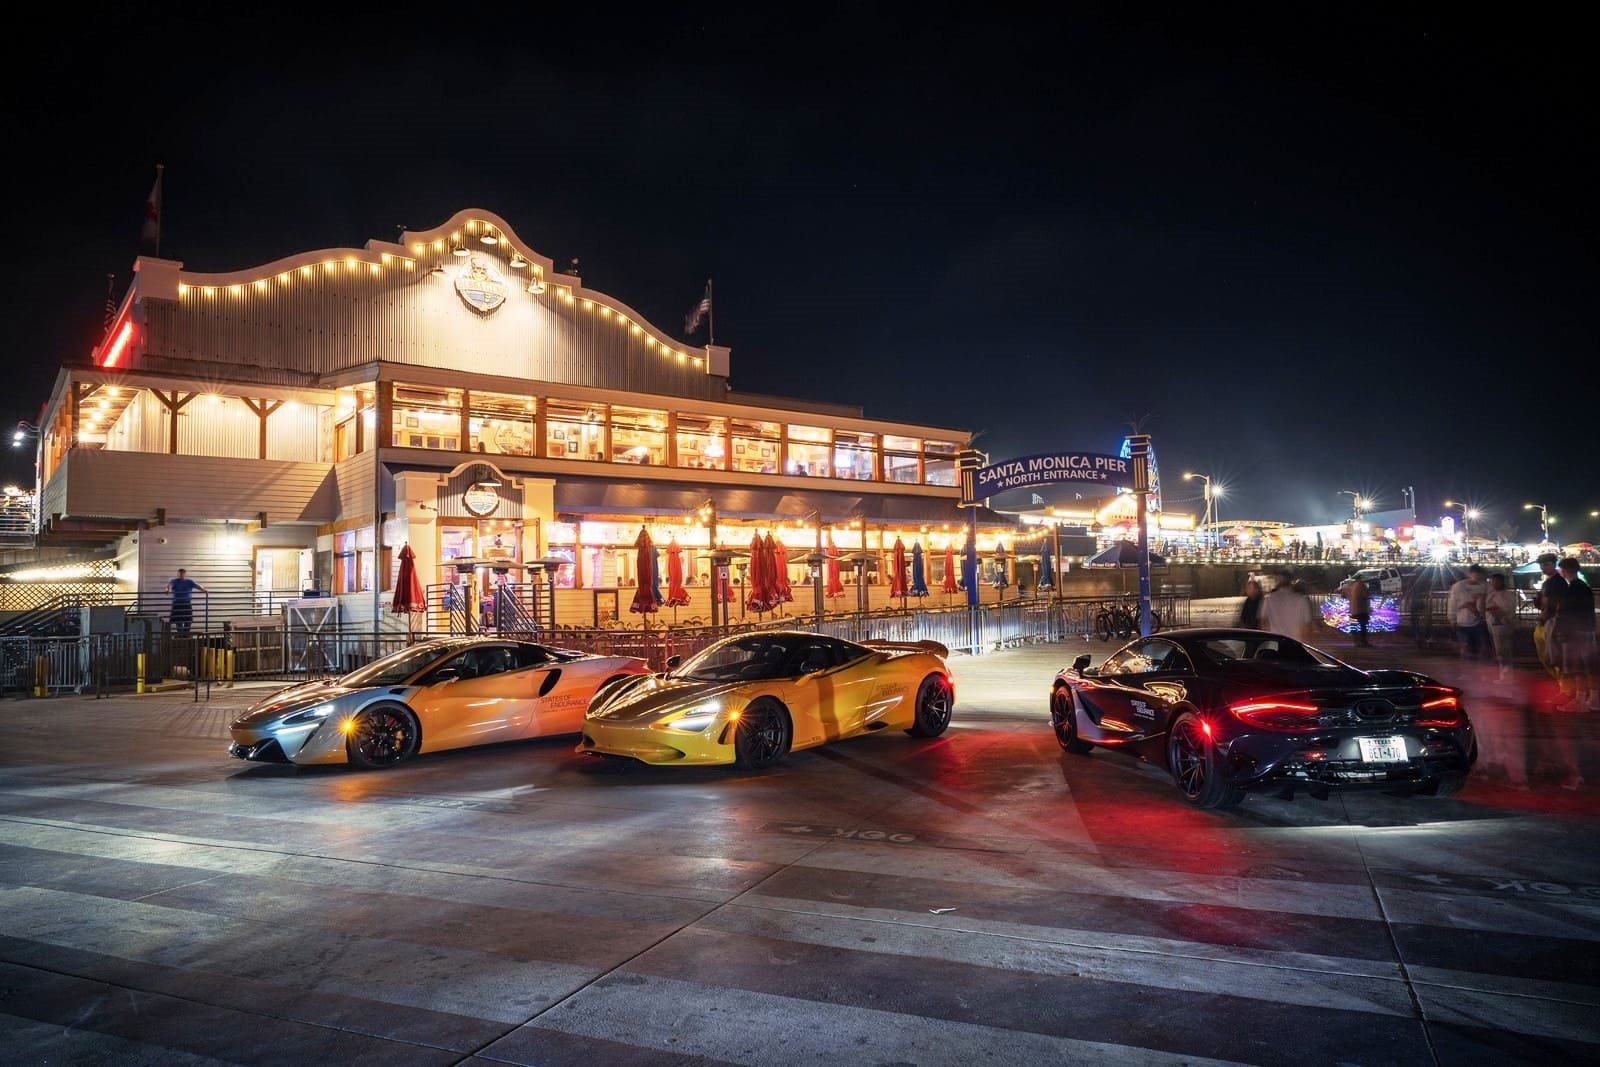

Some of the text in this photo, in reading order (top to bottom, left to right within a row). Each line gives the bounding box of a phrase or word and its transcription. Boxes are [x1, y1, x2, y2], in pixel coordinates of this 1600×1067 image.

[979, 456, 1127, 485] SANTA MONICA PIER
[1005, 469, 1098, 487] NORTH ENTRANCE
